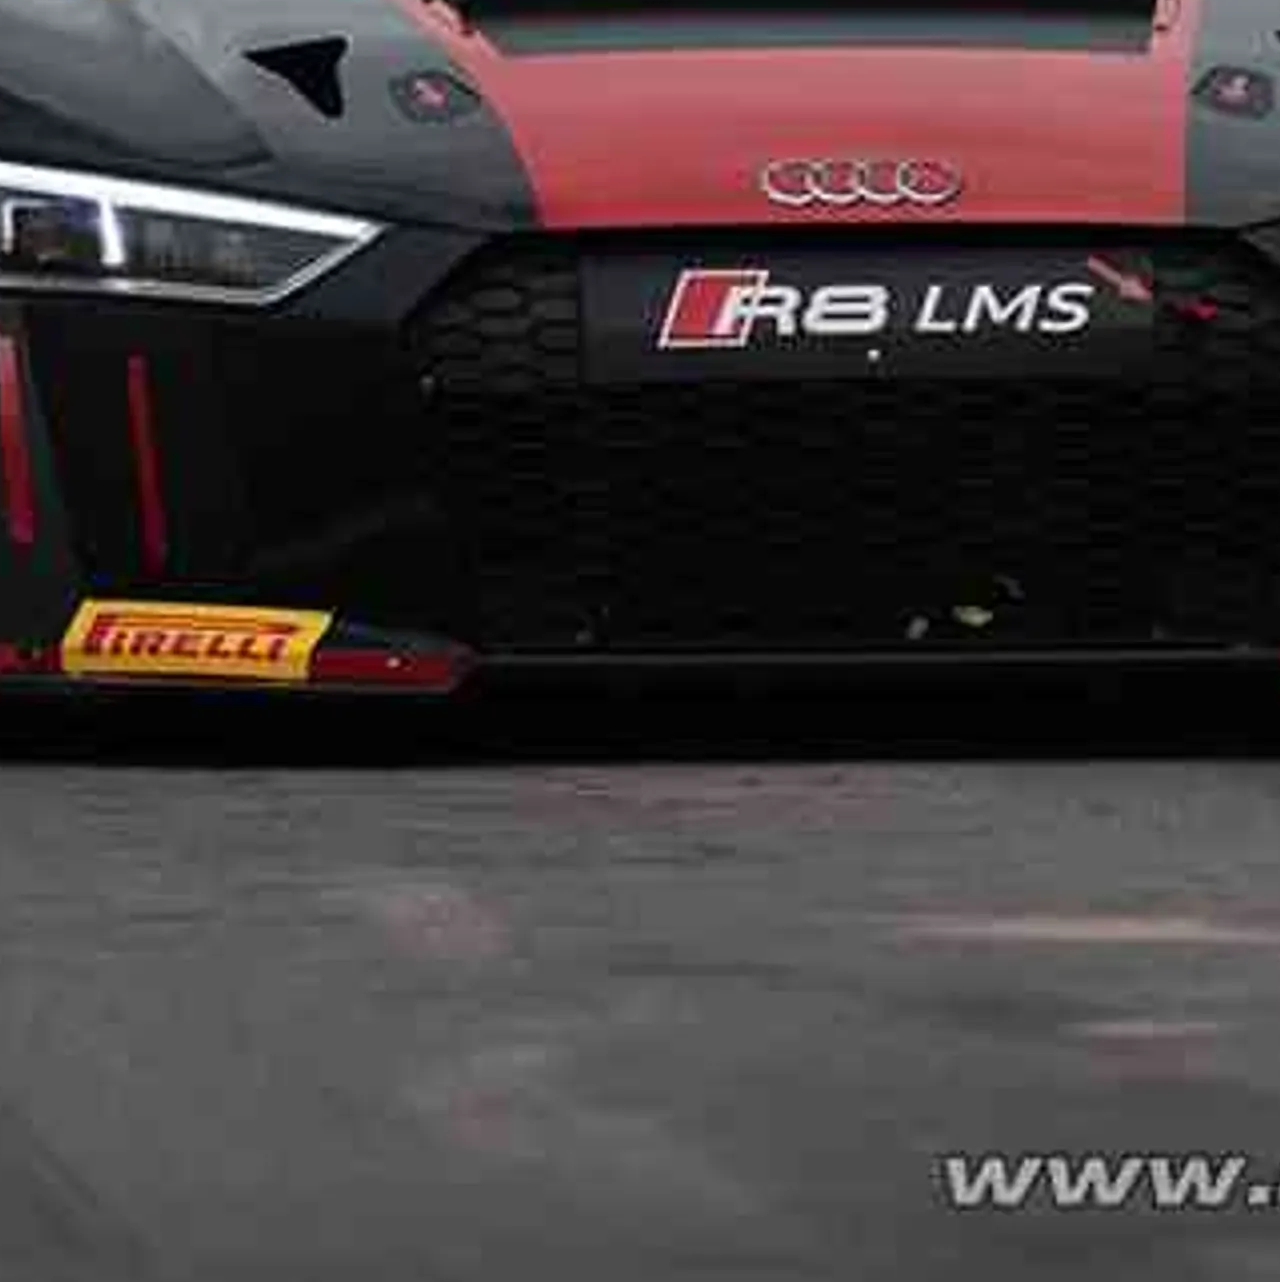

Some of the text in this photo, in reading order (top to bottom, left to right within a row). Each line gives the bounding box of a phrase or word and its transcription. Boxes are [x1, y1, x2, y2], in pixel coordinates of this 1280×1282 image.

[710, 284, 1096, 336] R8 LMS
[83, 612, 300, 662] PIRELLI
